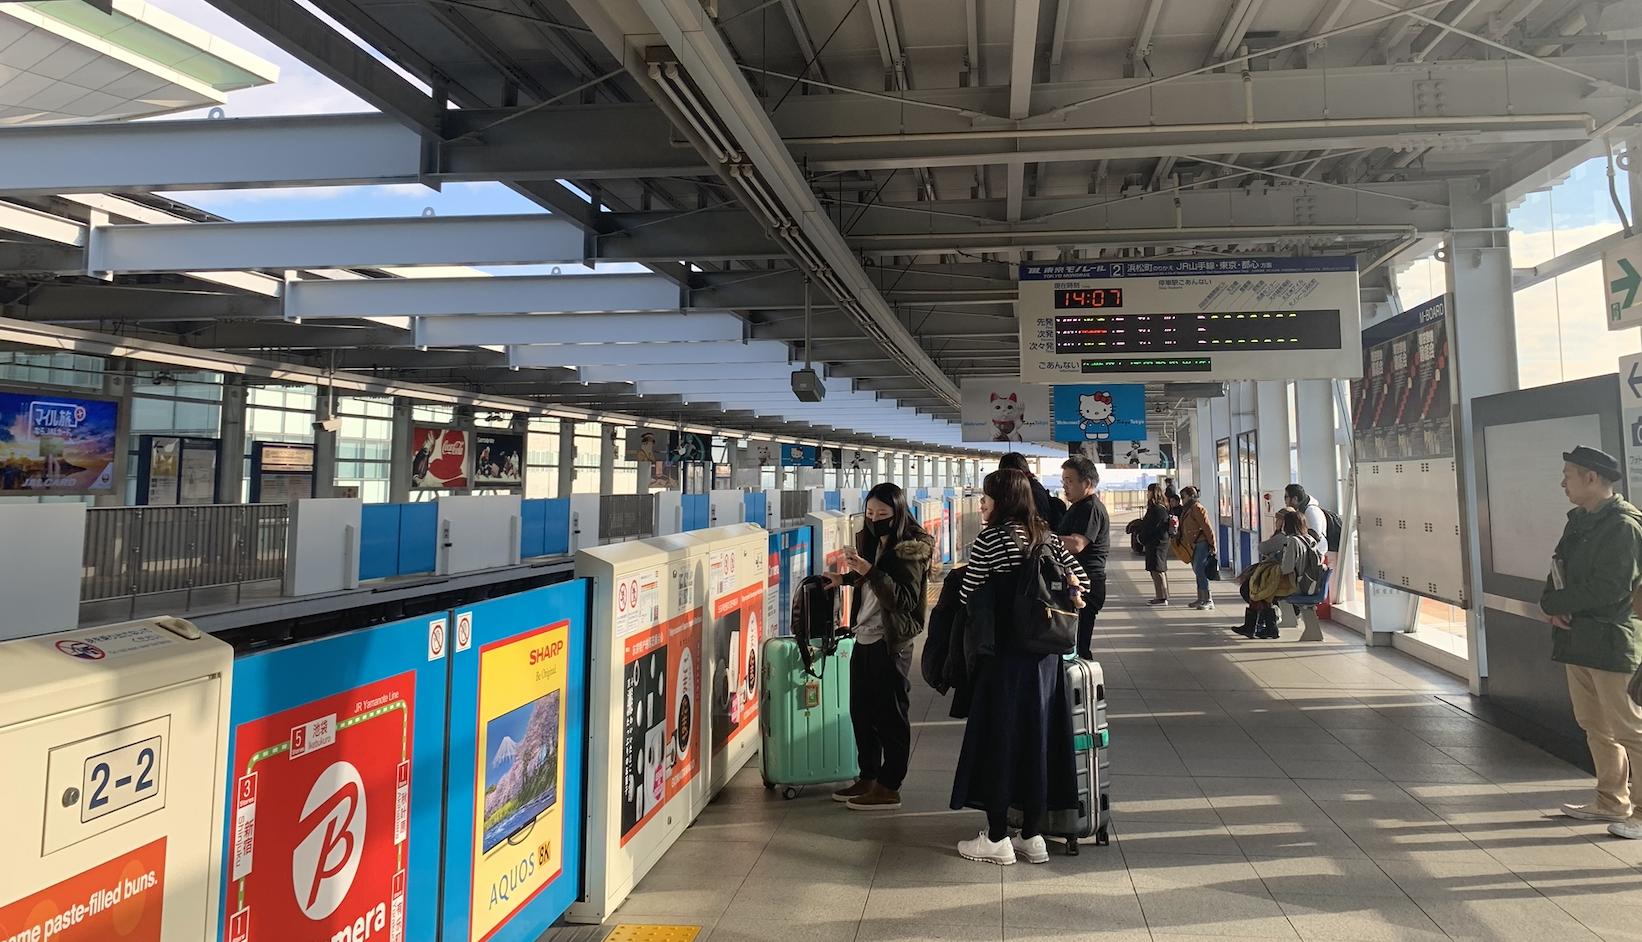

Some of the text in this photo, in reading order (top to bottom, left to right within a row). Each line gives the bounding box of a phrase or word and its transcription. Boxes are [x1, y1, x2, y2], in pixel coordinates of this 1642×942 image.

[1113, 265, 1121, 276] 2
[1064, 290, 1121, 307] 14:07
[1037, 318, 1053, 326] 先発
[1419, 303, 1444, 323] M-BOARD
[1037, 330, 1054, 338] 次発
[1029, 342, 1054, 350] 次々発
[529, 640, 563, 665] SHARP
[354, 690, 399, 713] JR Yamanote Line
[295, 729, 302, 747] 5
[89, 747, 154, 810] 2-2
[243, 780, 251, 797] 3
[236, 815, 245, 868] Shinjuku
[538, 841, 551, 867] 8K
[489, 851, 535, 910] AQUOS
[44, 881, 121, 940] paste-filled
[123, 869, 158, 898] buns.
